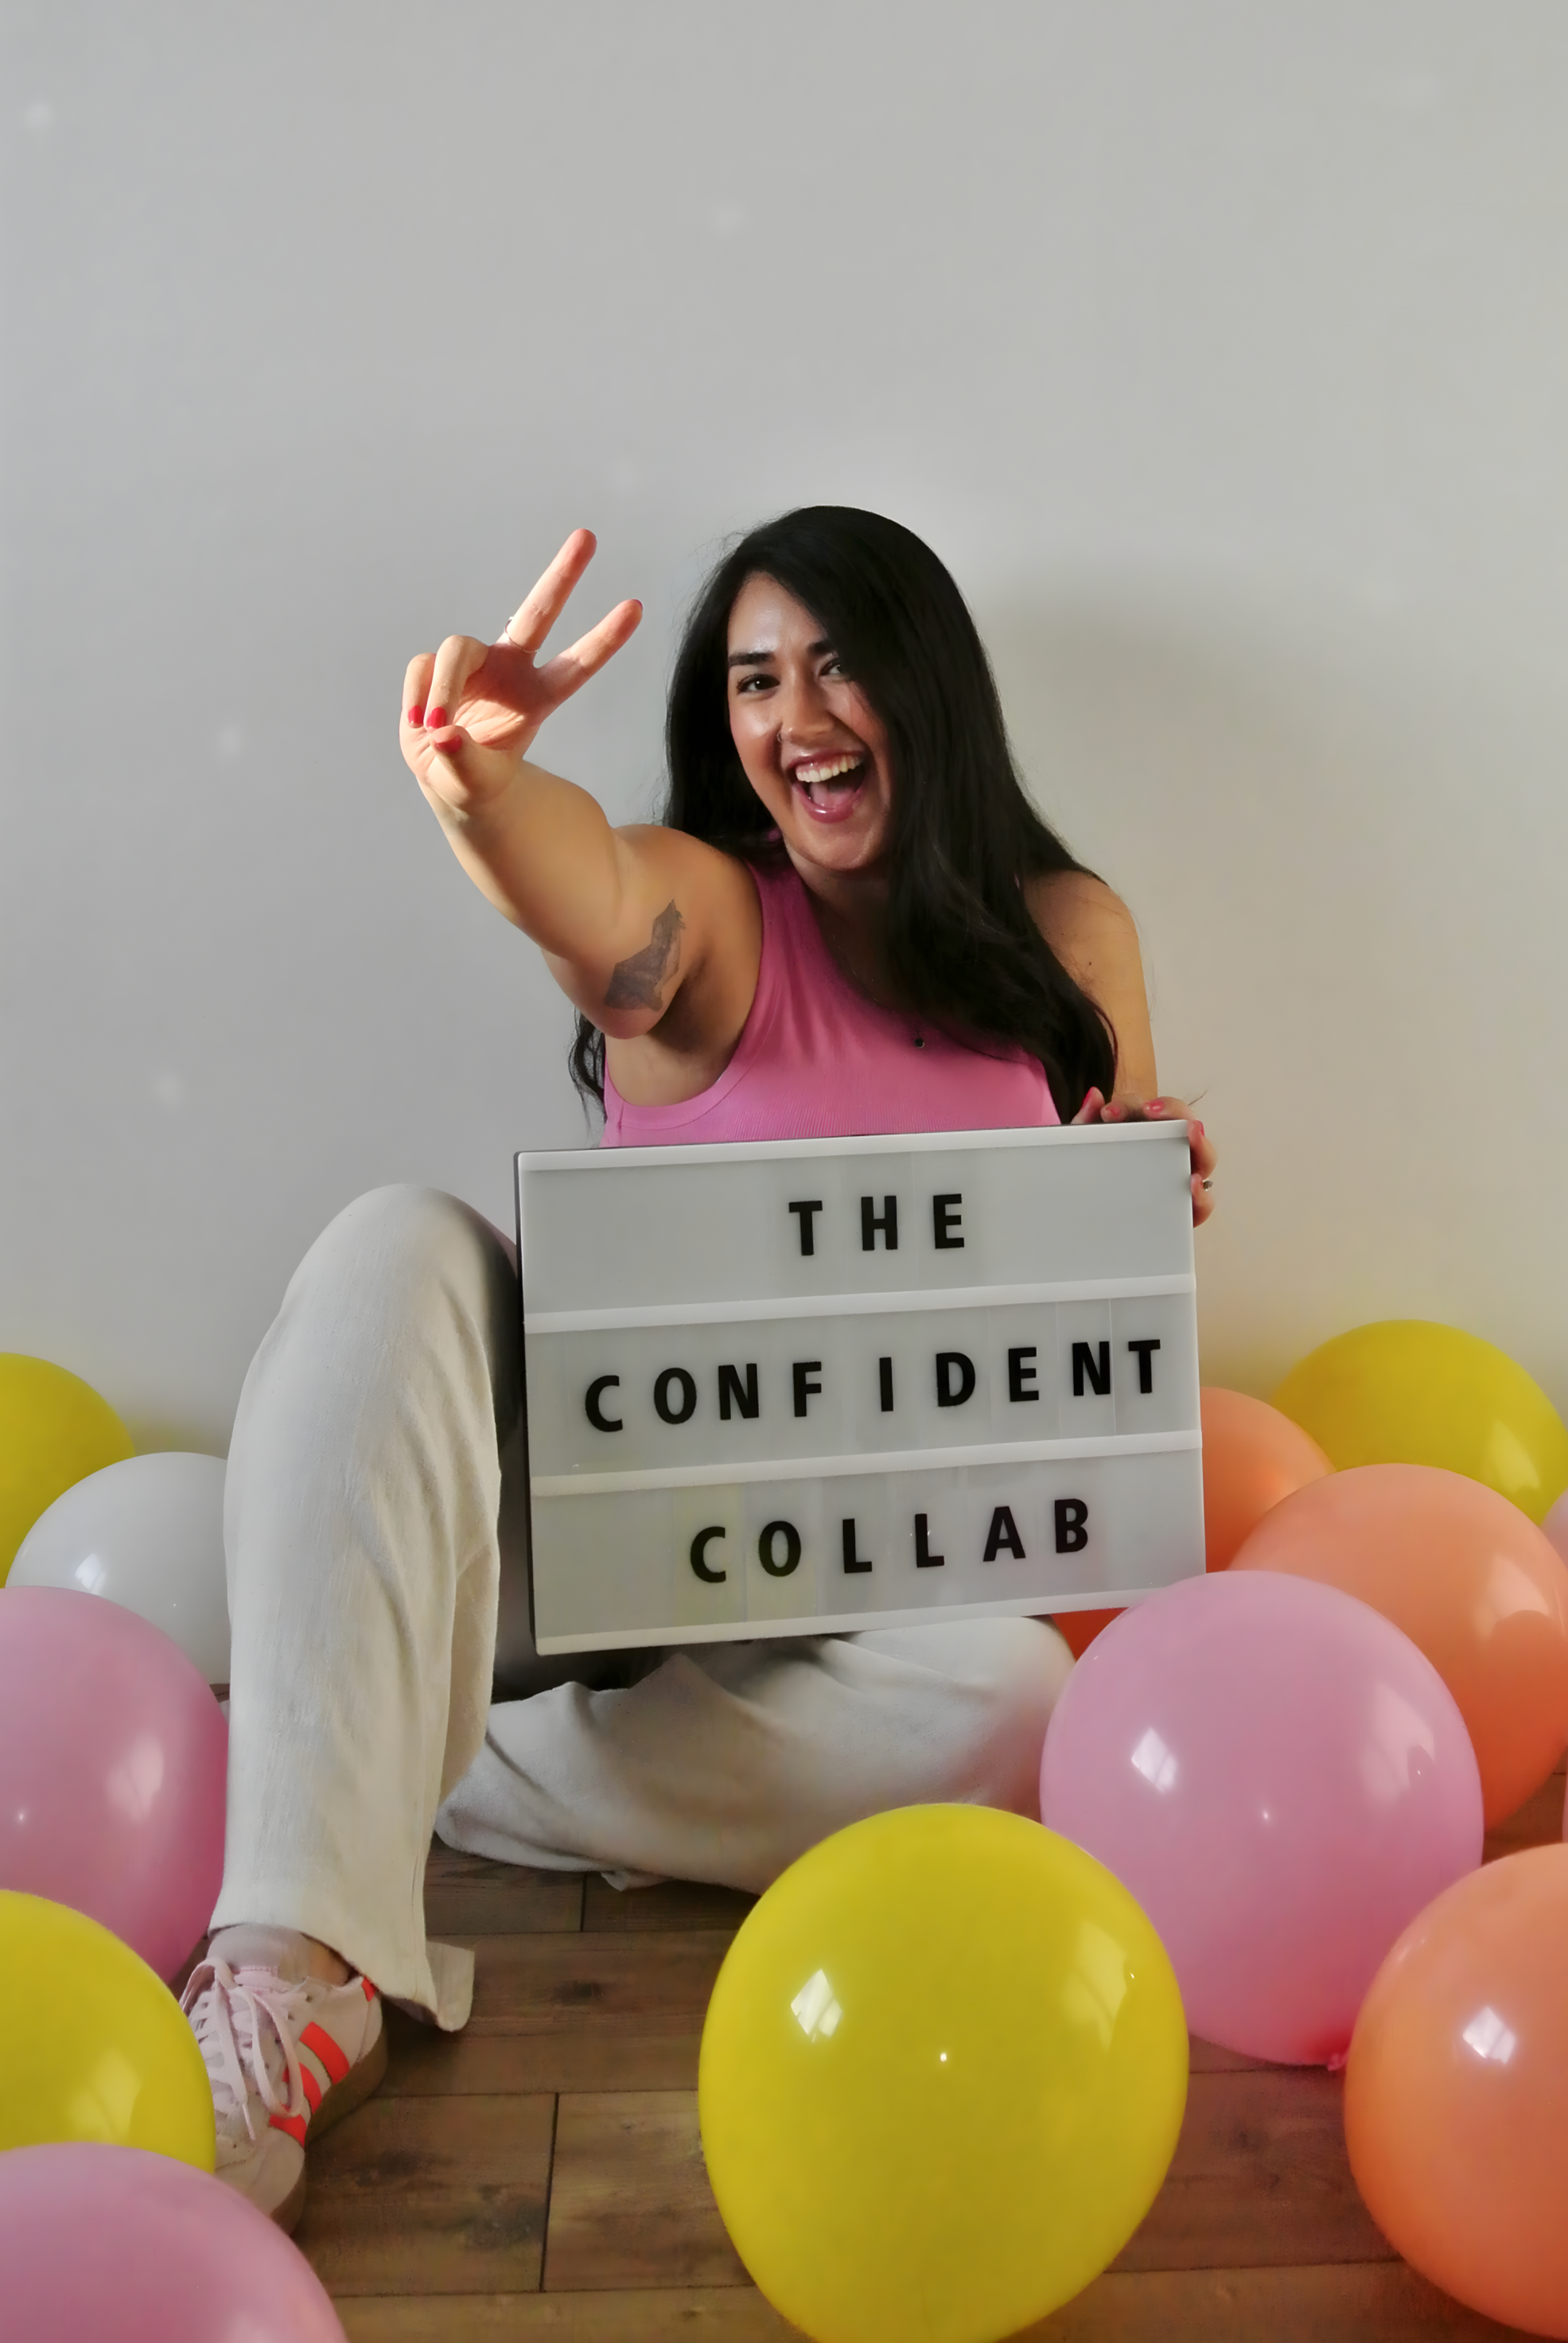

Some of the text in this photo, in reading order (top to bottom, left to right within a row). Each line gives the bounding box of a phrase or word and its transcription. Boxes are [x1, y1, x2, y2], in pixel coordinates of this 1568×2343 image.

[788, 1193, 964, 1256] THE
[584, 1339, 1161, 1433] CONFIDENT
[690, 1498, 1088, 1583] COLLAB
